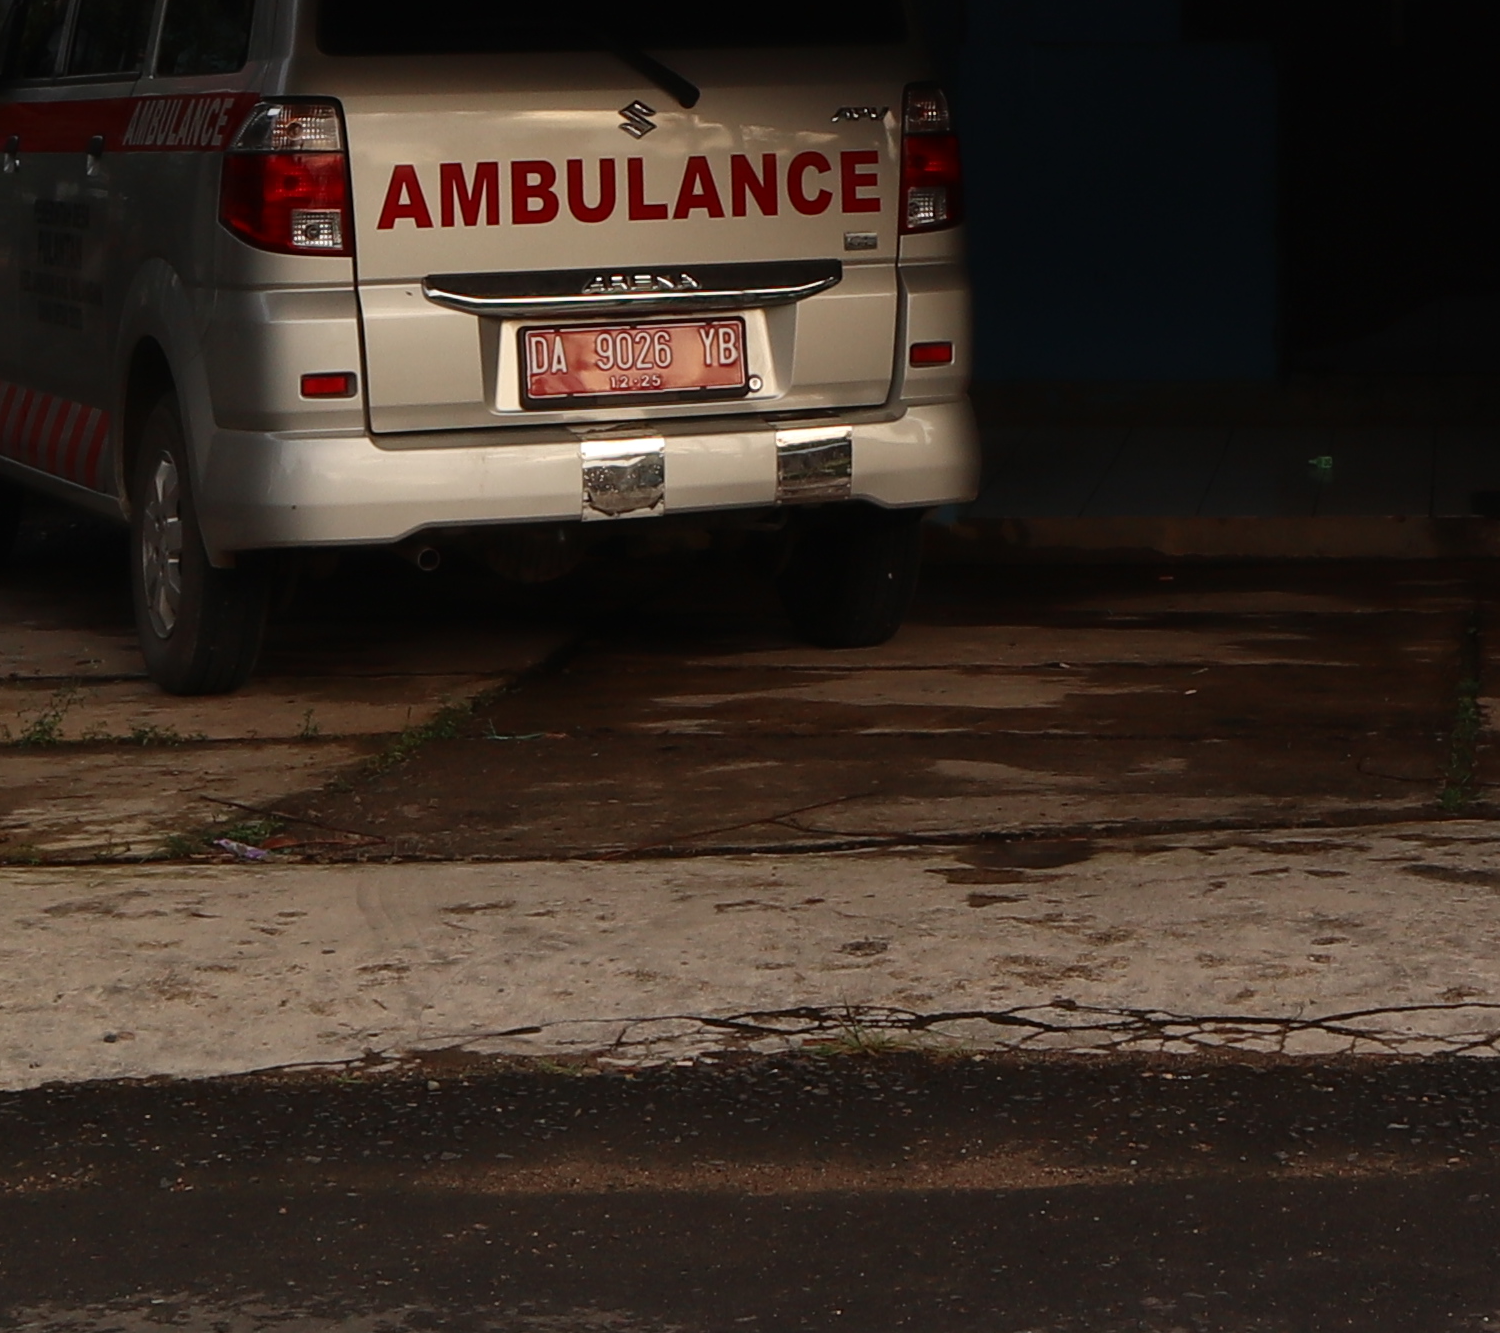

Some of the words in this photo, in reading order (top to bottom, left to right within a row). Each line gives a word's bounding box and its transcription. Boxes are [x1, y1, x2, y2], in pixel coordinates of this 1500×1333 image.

[122, 97, 236, 147] AMBULANCE
[377, 150, 881, 231] AMBULANCE
[581, 273, 702, 294] ARENA
[530, 333, 567, 375] DA
[595, 331, 673, 371] 9026
[699, 327, 739, 366] YB
